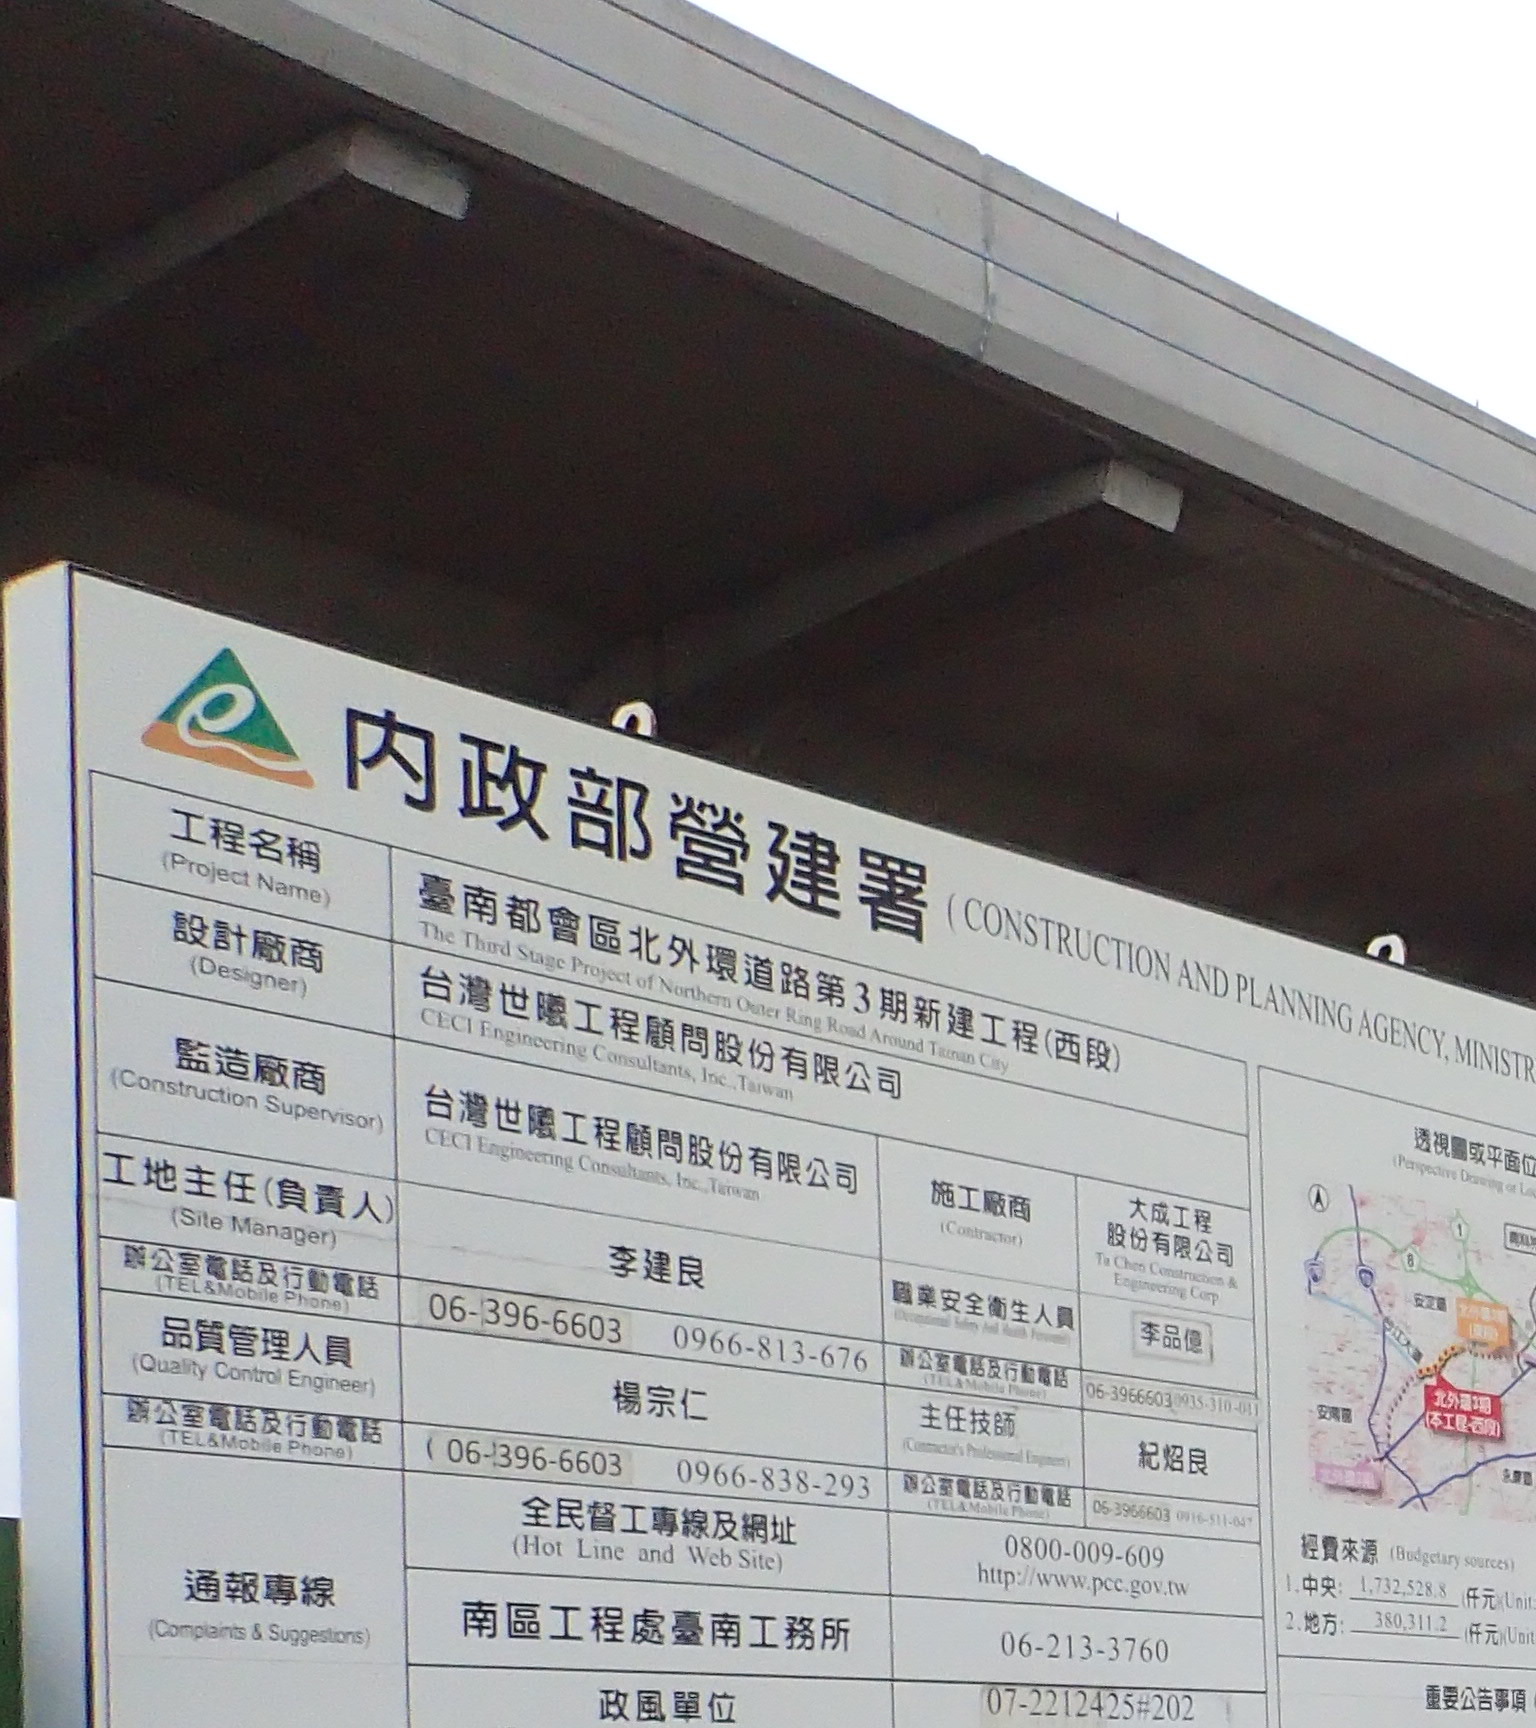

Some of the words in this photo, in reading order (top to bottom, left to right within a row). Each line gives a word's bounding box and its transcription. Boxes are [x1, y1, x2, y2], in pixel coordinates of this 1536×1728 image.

[171, 808, 321, 873] 工程名稱
[345, 707, 928, 944] 內政部營建署
[162, 852, 250, 884] (Project
[257, 873, 330, 908] Name)
[172, 910, 323, 973] 設計廠商
[190, 955, 307, 998] (Designer)
[418, 920, 456, 945] The
[464, 930, 511, 957] Third
[515, 942, 565, 972] Stage
[571, 956, 631, 986] Project
[636, 971, 655, 990] of
[659, 976, 731, 1008] Northern
[737, 995, 780, 1021] Outer
[785, 1006, 822, 1033] Ring
[827, 1016, 866, 1041] Road
[870, 1026, 924, 1054] Around
[980, 1052, 1009, 1075] City
[1177, 958, 1229, 999] AND
[1235, 972, 1353, 1034] PLANNING
[1358, 1009, 1449, 1063] AGENCY,
[420, 1008, 472, 1034] CECI
[480, 1022, 587, 1060] Engineering
[175, 1037, 326, 1095] 監造廠商
[110, 1068, 258, 1109] (Construction
[265, 1095, 384, 1134] Supervisor)
[424, 1128, 471, 1151] CECI
[477, 1136, 573, 1172] Engineering
[103, 1152, 393, 1224] 工地主任(負責人)
[931, 1179, 1030, 1223] 施工廠商
[172, 1207, 223, 1229] (Site
[232, 1215, 337, 1249] Manager)
[1129, 1197, 1212, 1234] 大成工程
[1107, 1221, 1234, 1267] 股份有限公司
[608, 1245, 706, 1290] 李建良
[162, 1316, 352, 1368] 品質管理人員
[429, 1293, 622, 1345] 06-396-6603
[673, 1325, 868, 1373] 0966-813-676
[132, 1352, 208, 1381] (Quality
[215, 1361, 282, 1385] Control
[288, 1372, 375, 1397] Engineer)
[613, 1379, 709, 1421] 楊宗仁
[920, 1401, 1016, 1438] 主任技師
[447, 1438, 623, 1477] 06-396-6603
[676, 1459, 871, 1500] 0966-838-293
[521, 1496, 798, 1546] 全民督工專線及網址
[512, 1533, 562, 1558] (Hot
[577, 1537, 624, 1561] Line
[638, 1543, 674, 1564] and
[687, 1545, 732, 1567] Web
[738, 1548, 783, 1574] Site)
[1005, 1534, 1165, 1568] 0800-009-609
[1301, 1533, 1379, 1565] 經費來源
[1390, 1545, 1460, 1570] (Budgetary
[185, 1569, 335, 1608] 通報專線
[977, 1562, 1190, 1598] http://www.pcc.gov.tw
[149, 1618, 245, 1641] (Complaints
[251, 1623, 263, 1640] &
[268, 1624, 371, 1647] Suggestions)
[462, 1601, 851, 1653] 南區工程處臺南工務所
[1001, 1632, 1169, 1663] 06-213-3760
[599, 1689, 736, 1724] 政風單位
[986, 1687, 1195, 1721] 07-2212425#202
[1425, 1685, 1527, 1712] 重要公告事項
